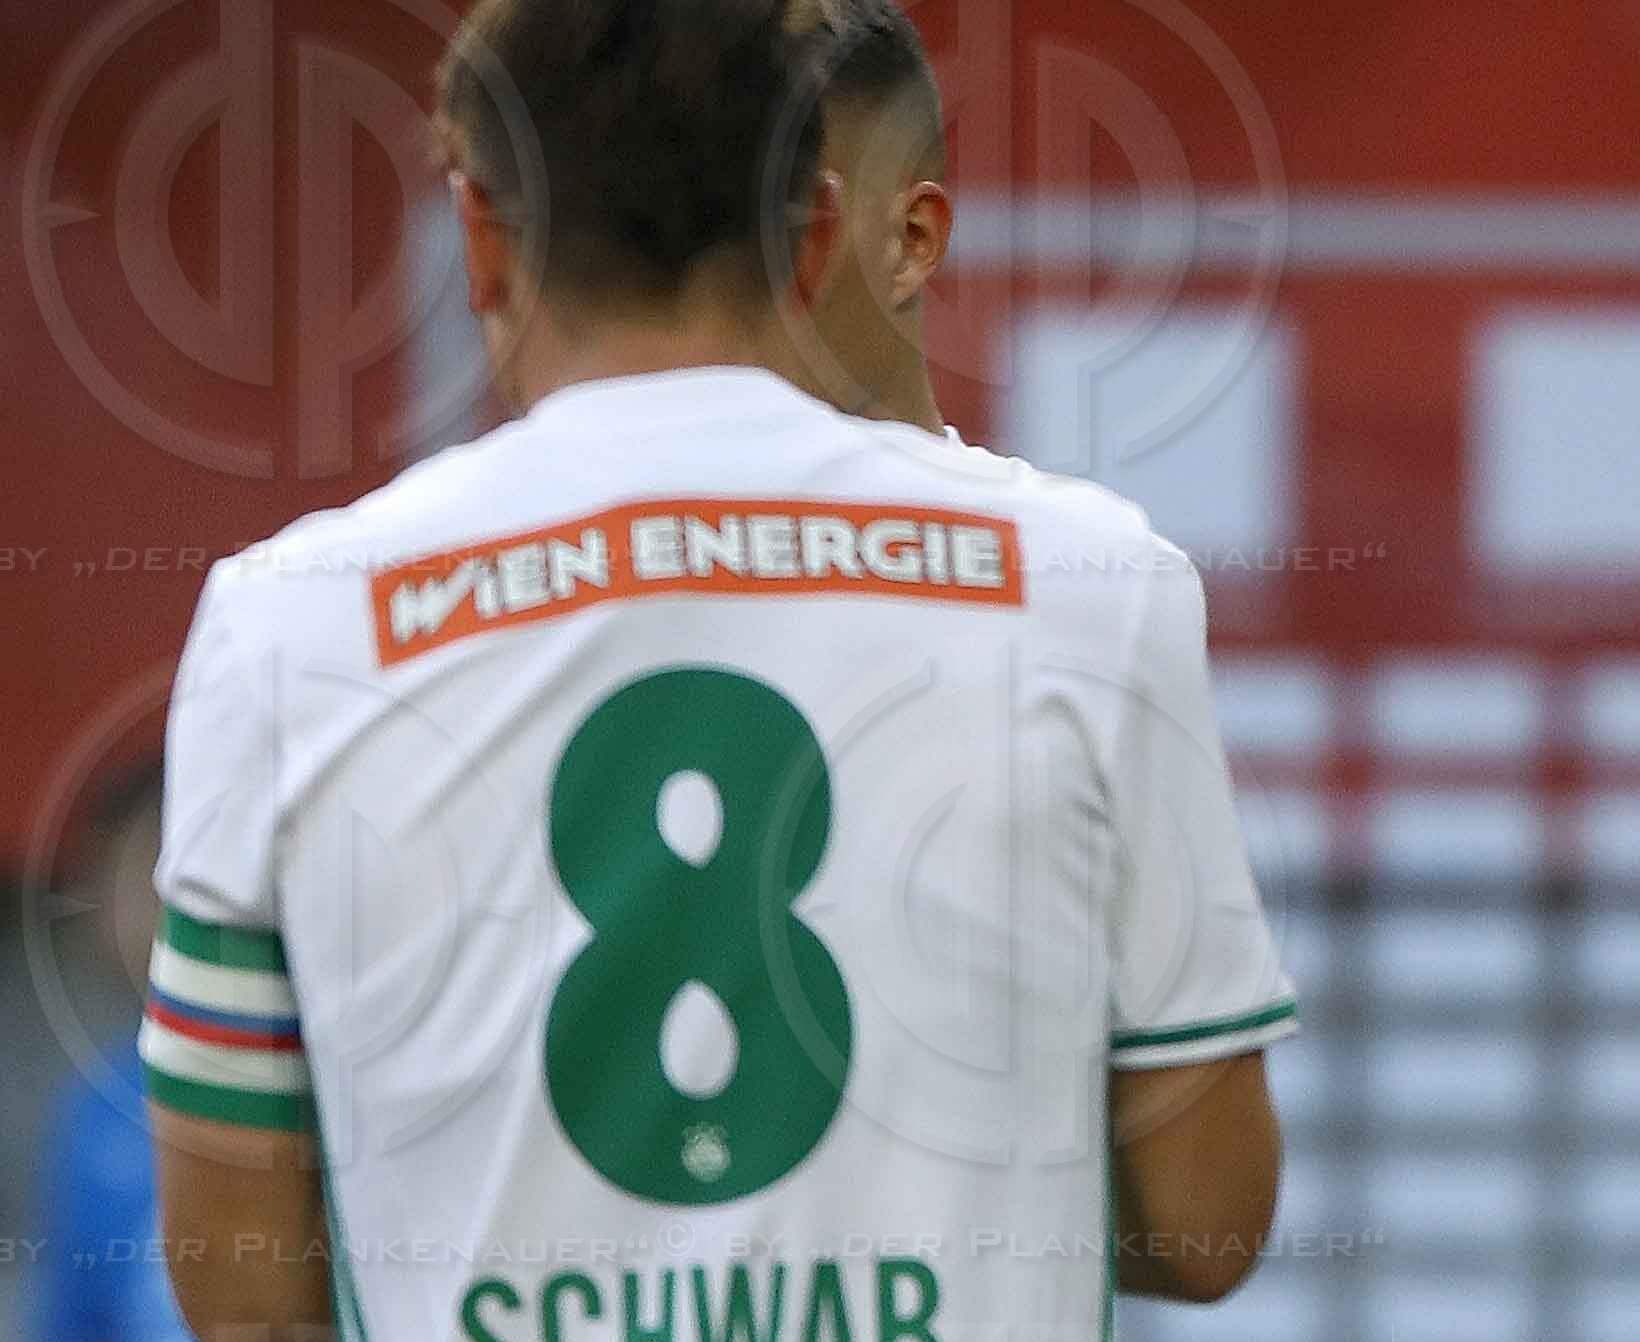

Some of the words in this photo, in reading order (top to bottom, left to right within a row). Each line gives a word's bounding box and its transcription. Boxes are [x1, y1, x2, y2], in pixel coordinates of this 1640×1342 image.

[389, 527, 612, 647] WIEN
[628, 512, 1008, 589] ENERGIE
[543, 668, 856, 1208] 8
